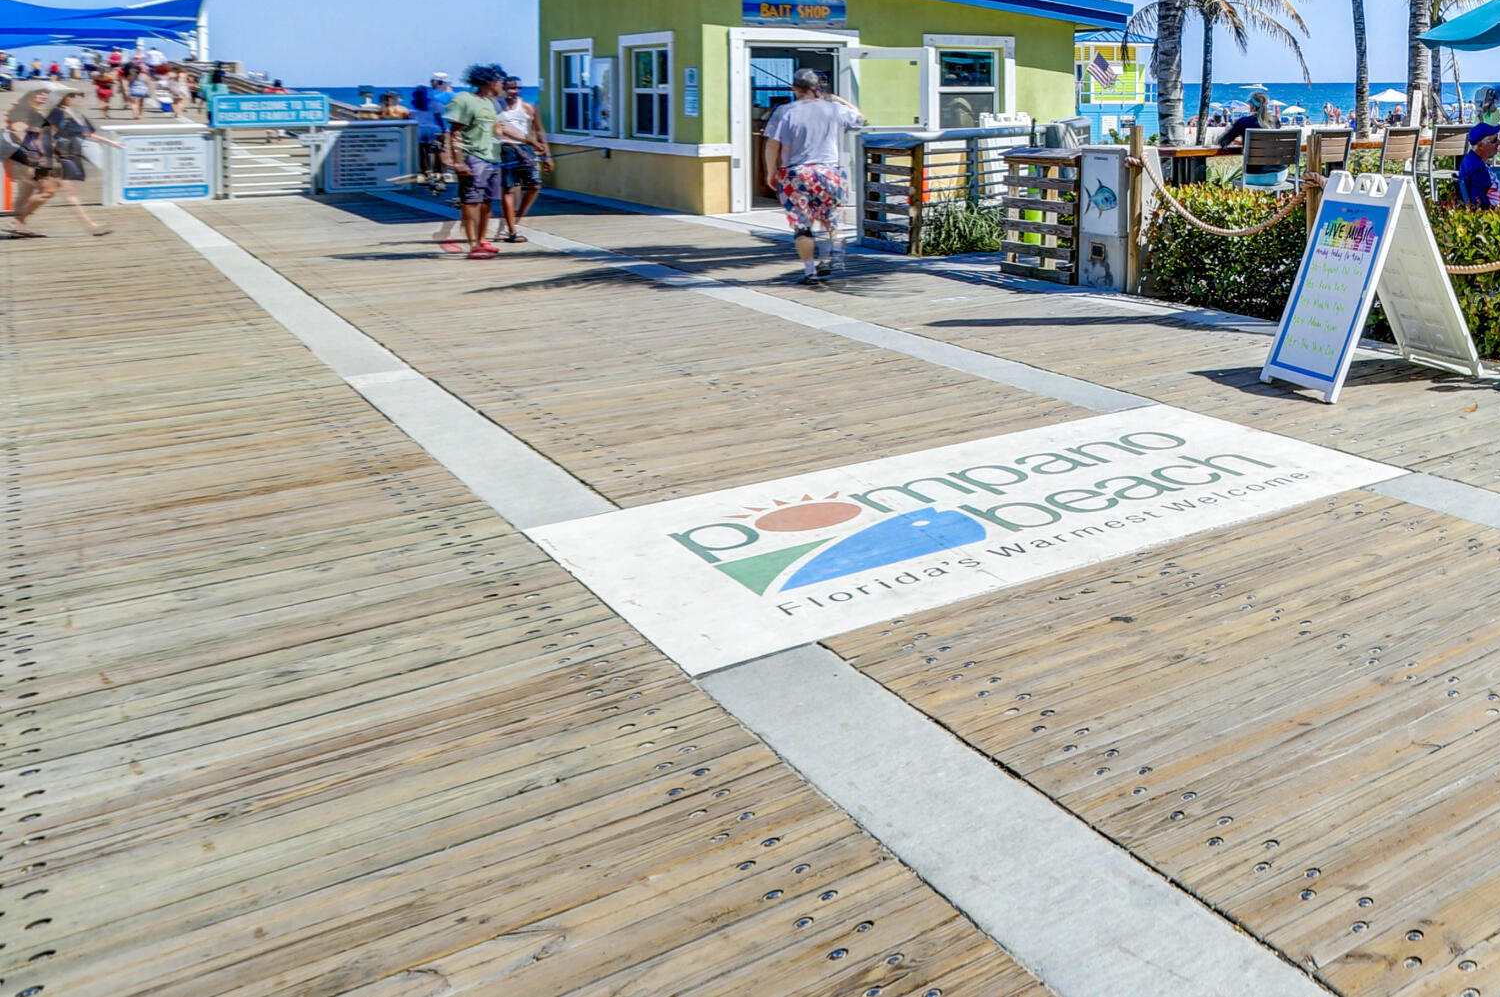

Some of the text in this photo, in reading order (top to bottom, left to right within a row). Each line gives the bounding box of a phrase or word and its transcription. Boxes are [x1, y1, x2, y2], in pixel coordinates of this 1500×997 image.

[760, 2, 831, 19] BAIT SHOP
[1325, 222, 1374, 245] LIVE MUSIC
[959, 452, 1277, 532] beach
[777, 469, 1310, 616] Florida's Warmest Welcome
